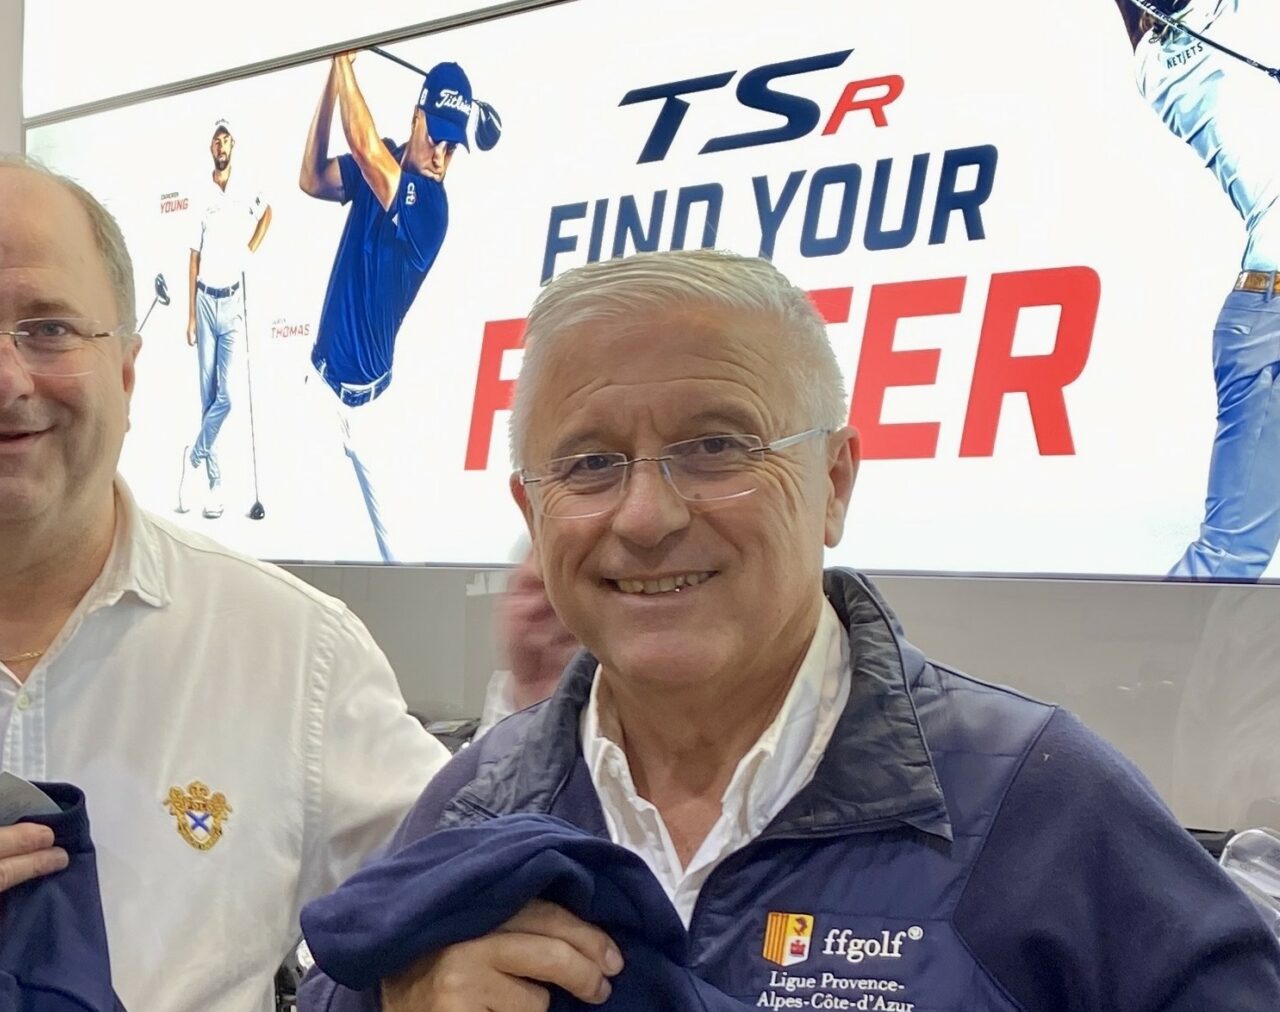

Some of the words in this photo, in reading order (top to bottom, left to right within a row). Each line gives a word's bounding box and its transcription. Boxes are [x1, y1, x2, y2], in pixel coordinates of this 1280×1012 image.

[1166, 42, 1205, 69] NETJETS
[617, 48, 905, 165] TSR
[160, 197, 189, 214] YOUNG
[540, 182, 724, 287] FIND
[752, 144, 999, 262] YOUR
[271, 323, 311, 339] THOMAS
[769, 971, 816, 992] Ligue
[821, 973, 905, 992] Provence-
